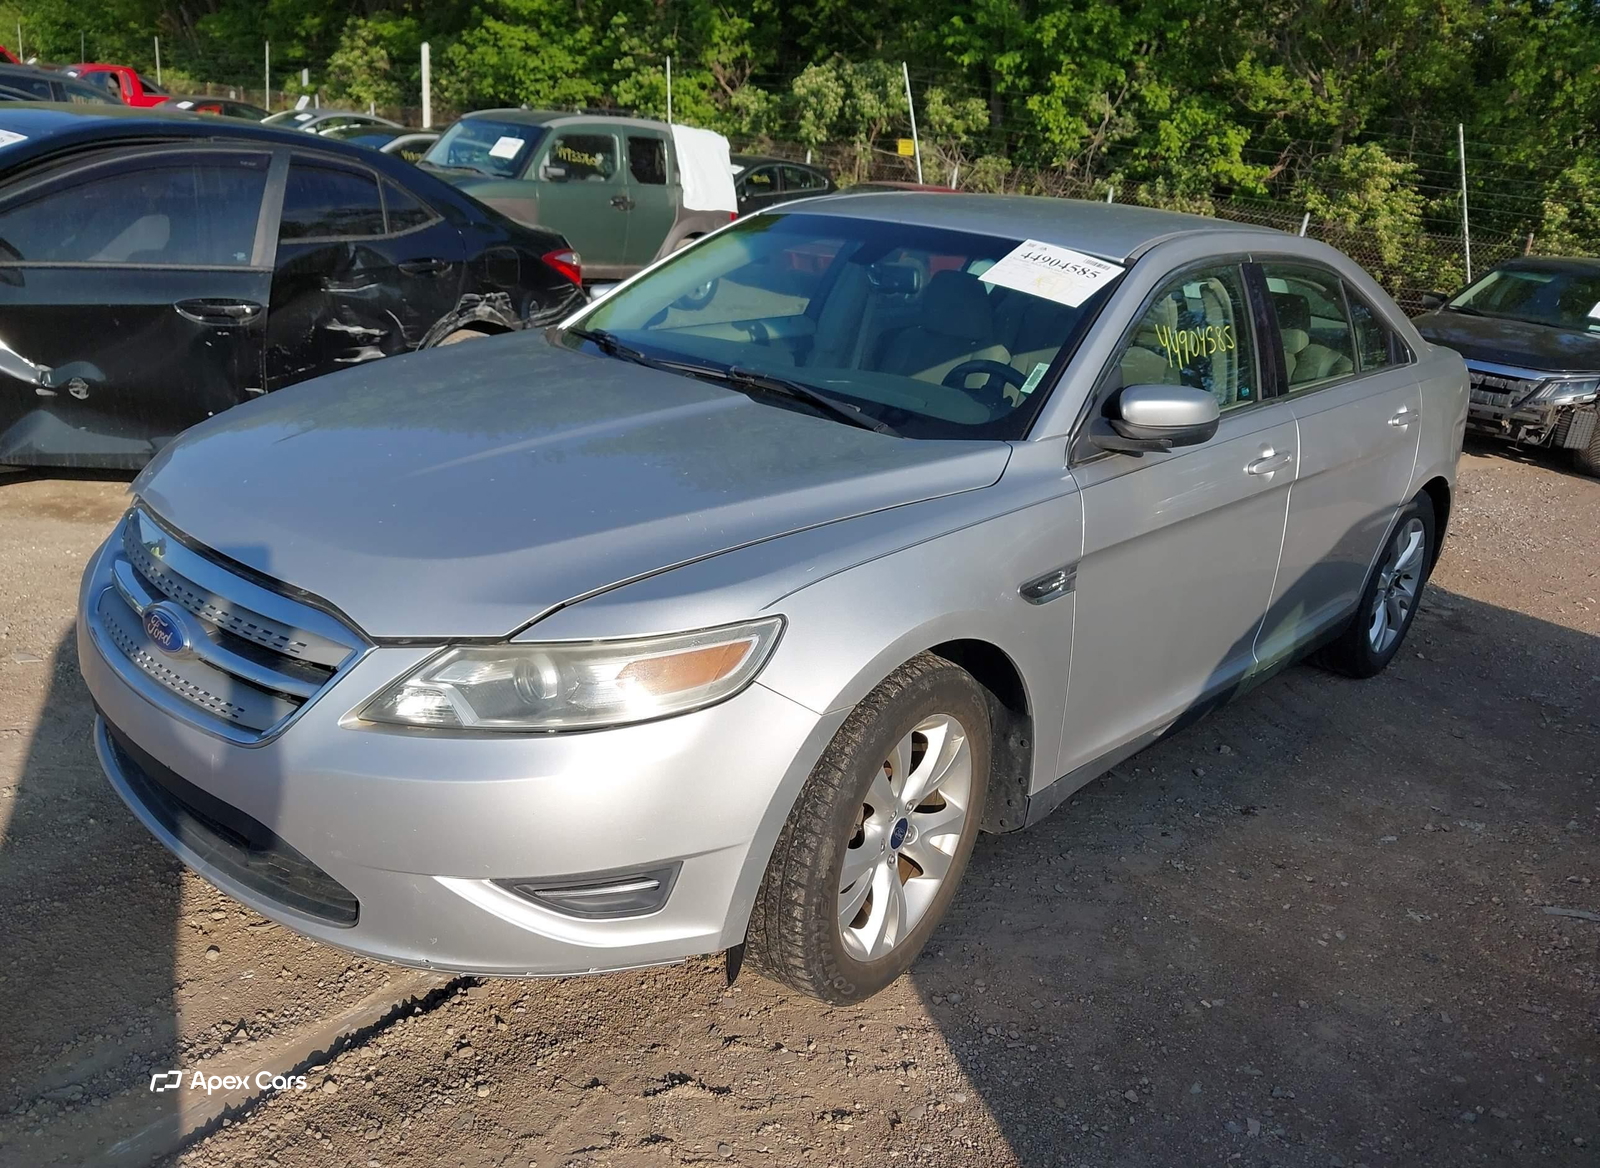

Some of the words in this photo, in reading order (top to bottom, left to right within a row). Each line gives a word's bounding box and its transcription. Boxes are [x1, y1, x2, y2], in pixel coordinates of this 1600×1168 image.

[1021, 251, 1101, 279] 44904585
[1154, 323, 1235, 370] 44904585
[147, 614, 173, 646] Ford
